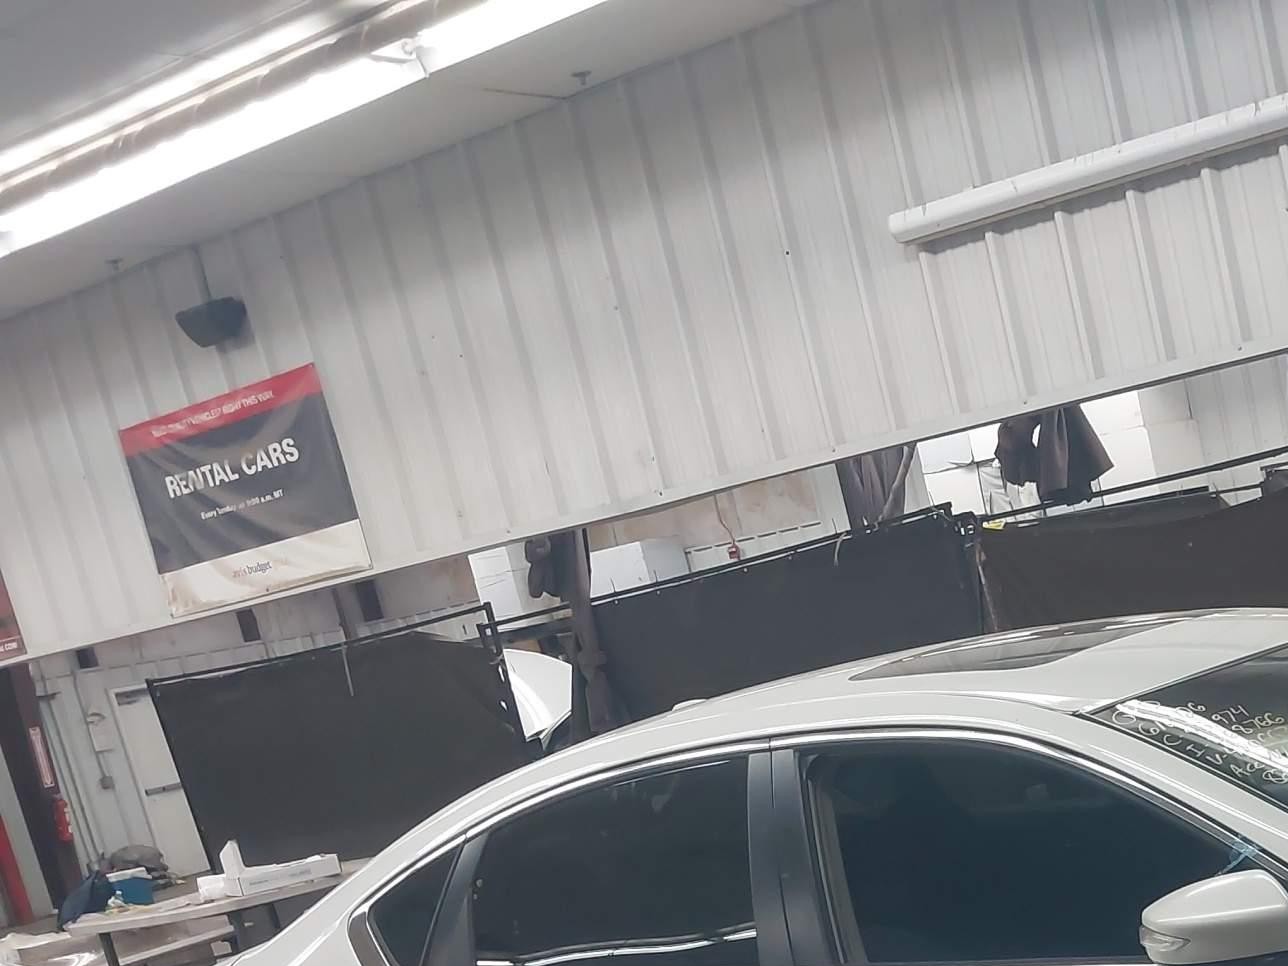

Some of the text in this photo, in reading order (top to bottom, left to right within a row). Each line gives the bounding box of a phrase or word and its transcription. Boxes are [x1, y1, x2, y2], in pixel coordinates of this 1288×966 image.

[165, 437, 299, 499] RENTAL CARS
[246, 561, 272, 574] budget
